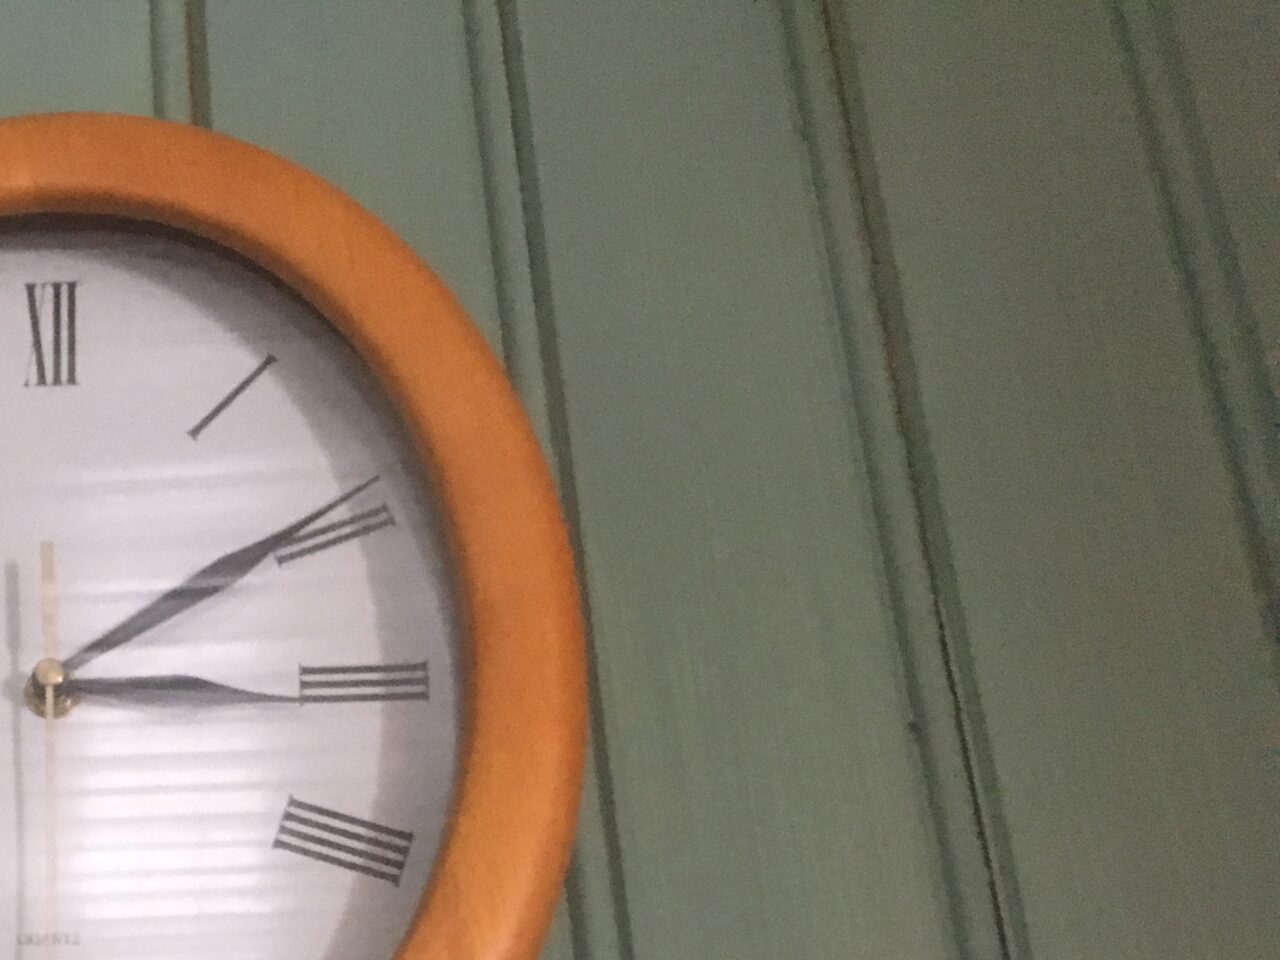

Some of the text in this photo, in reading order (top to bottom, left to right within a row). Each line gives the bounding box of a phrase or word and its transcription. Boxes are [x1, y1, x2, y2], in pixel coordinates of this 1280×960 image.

[23, 280, 79, 388] XII
[269, 501, 397, 568] II
[297, 660, 430, 704] III
[271, 794, 415, 888] IIII
